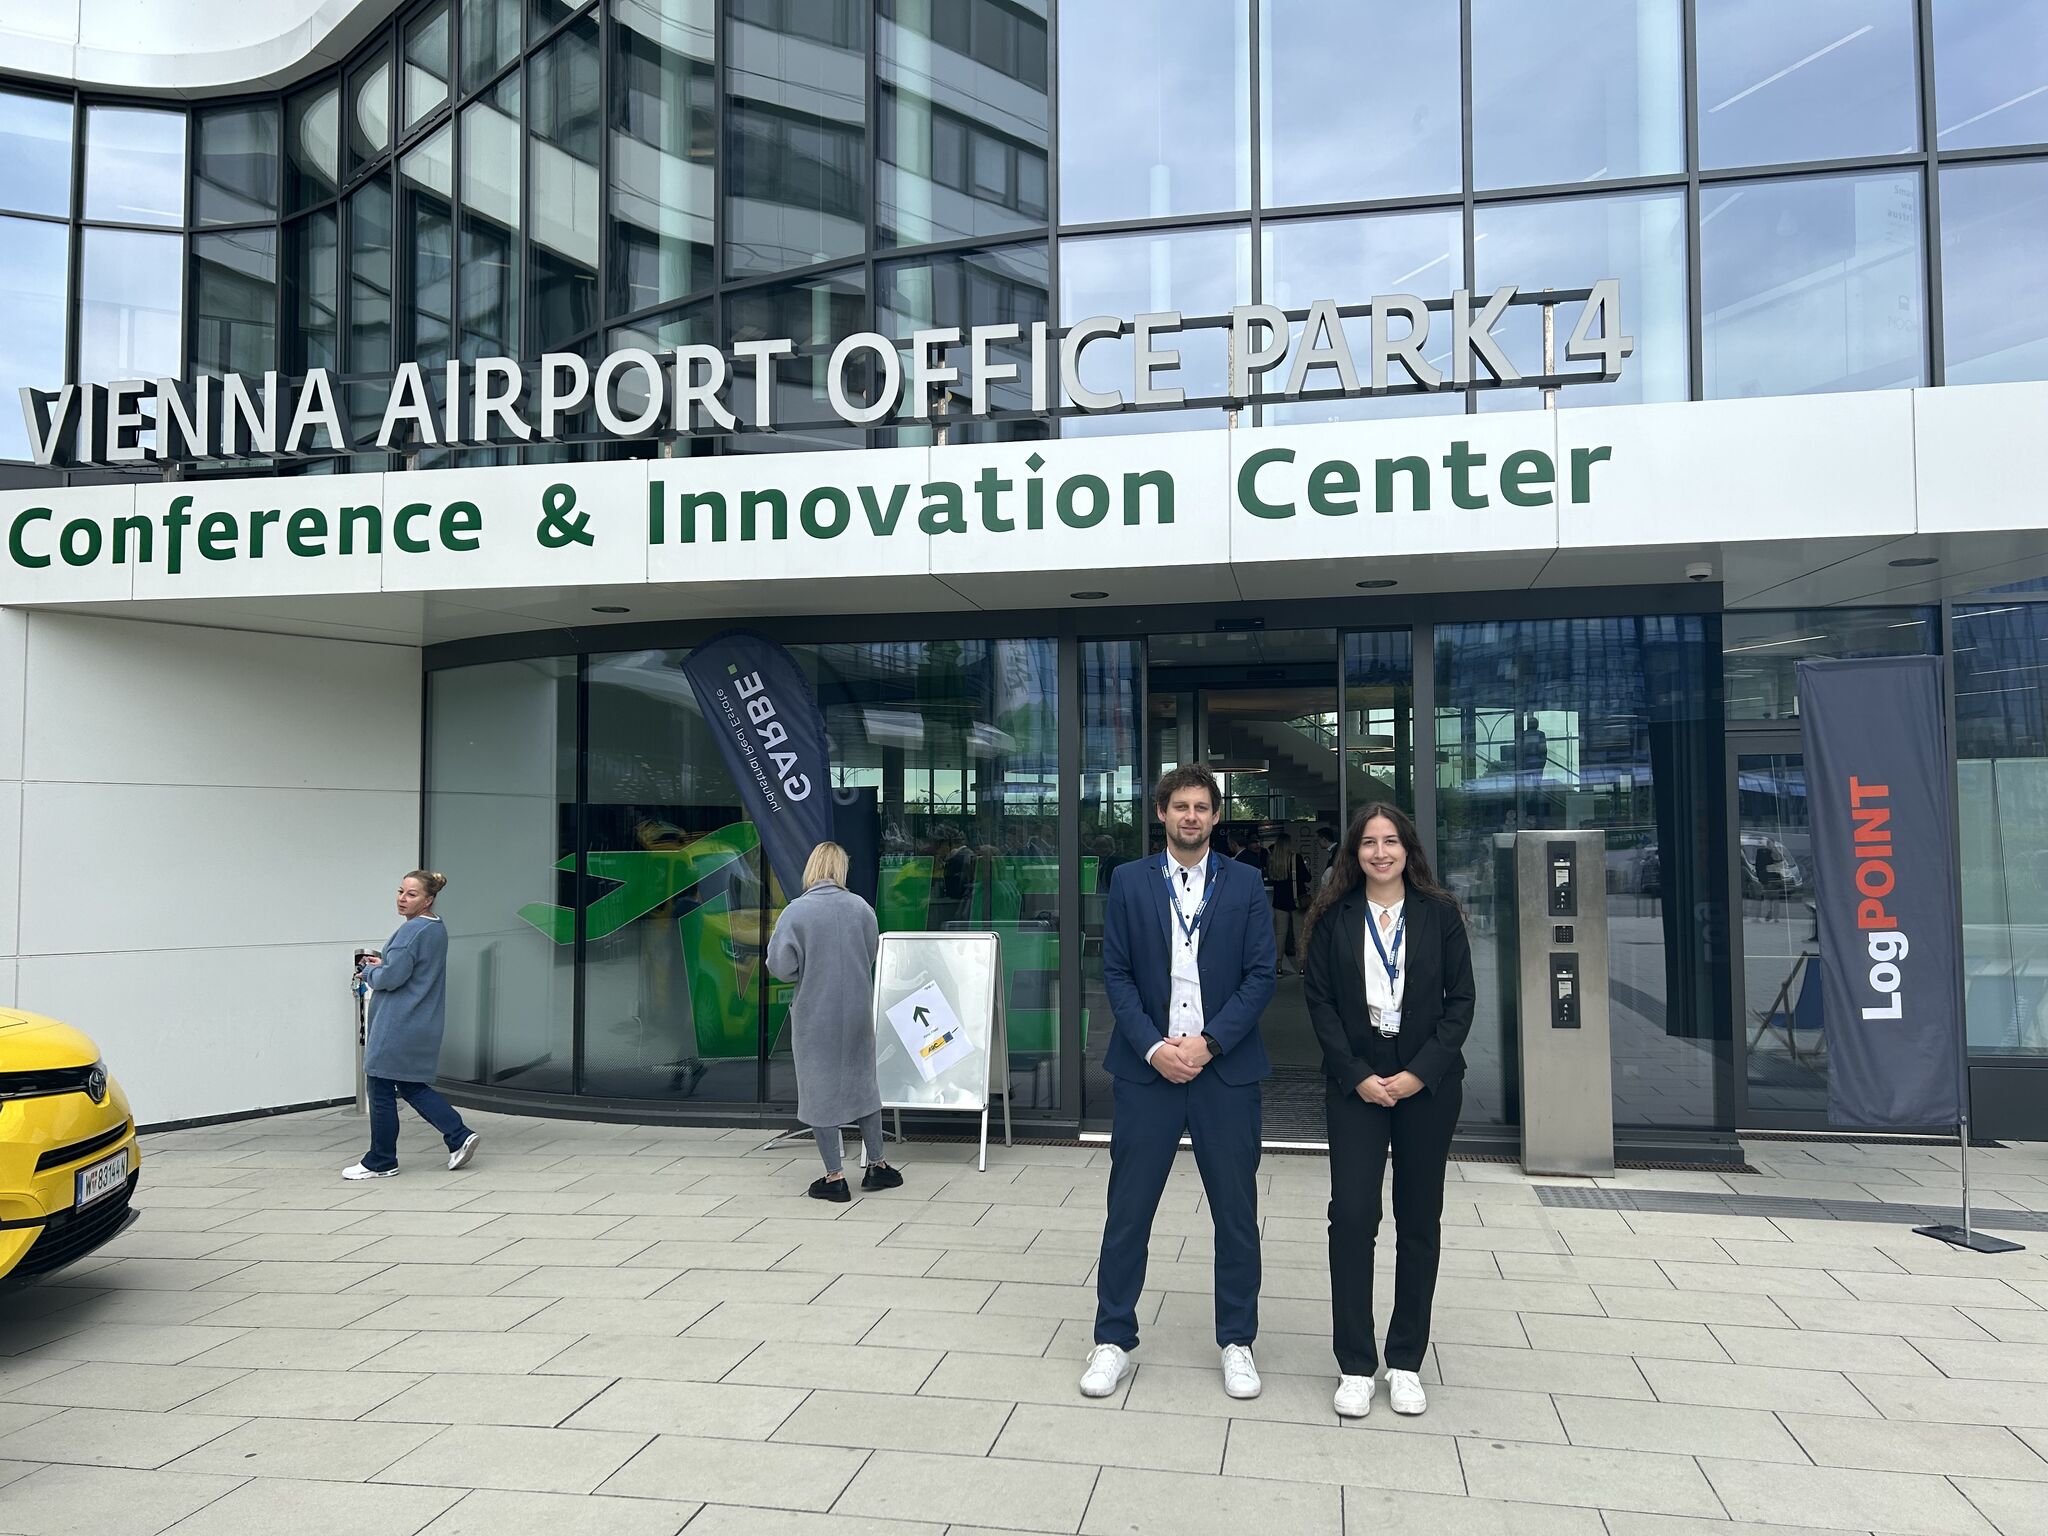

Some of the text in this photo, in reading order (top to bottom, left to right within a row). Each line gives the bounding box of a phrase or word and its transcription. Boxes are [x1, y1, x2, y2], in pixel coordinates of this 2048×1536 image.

[18, 278, 1633, 465] VIENNA AIRPORT OFFICE PARK 4
[8, 441, 1612, 574] Conference & Innovation Center
[1849, 776, 1908, 1020] LogPOINT
